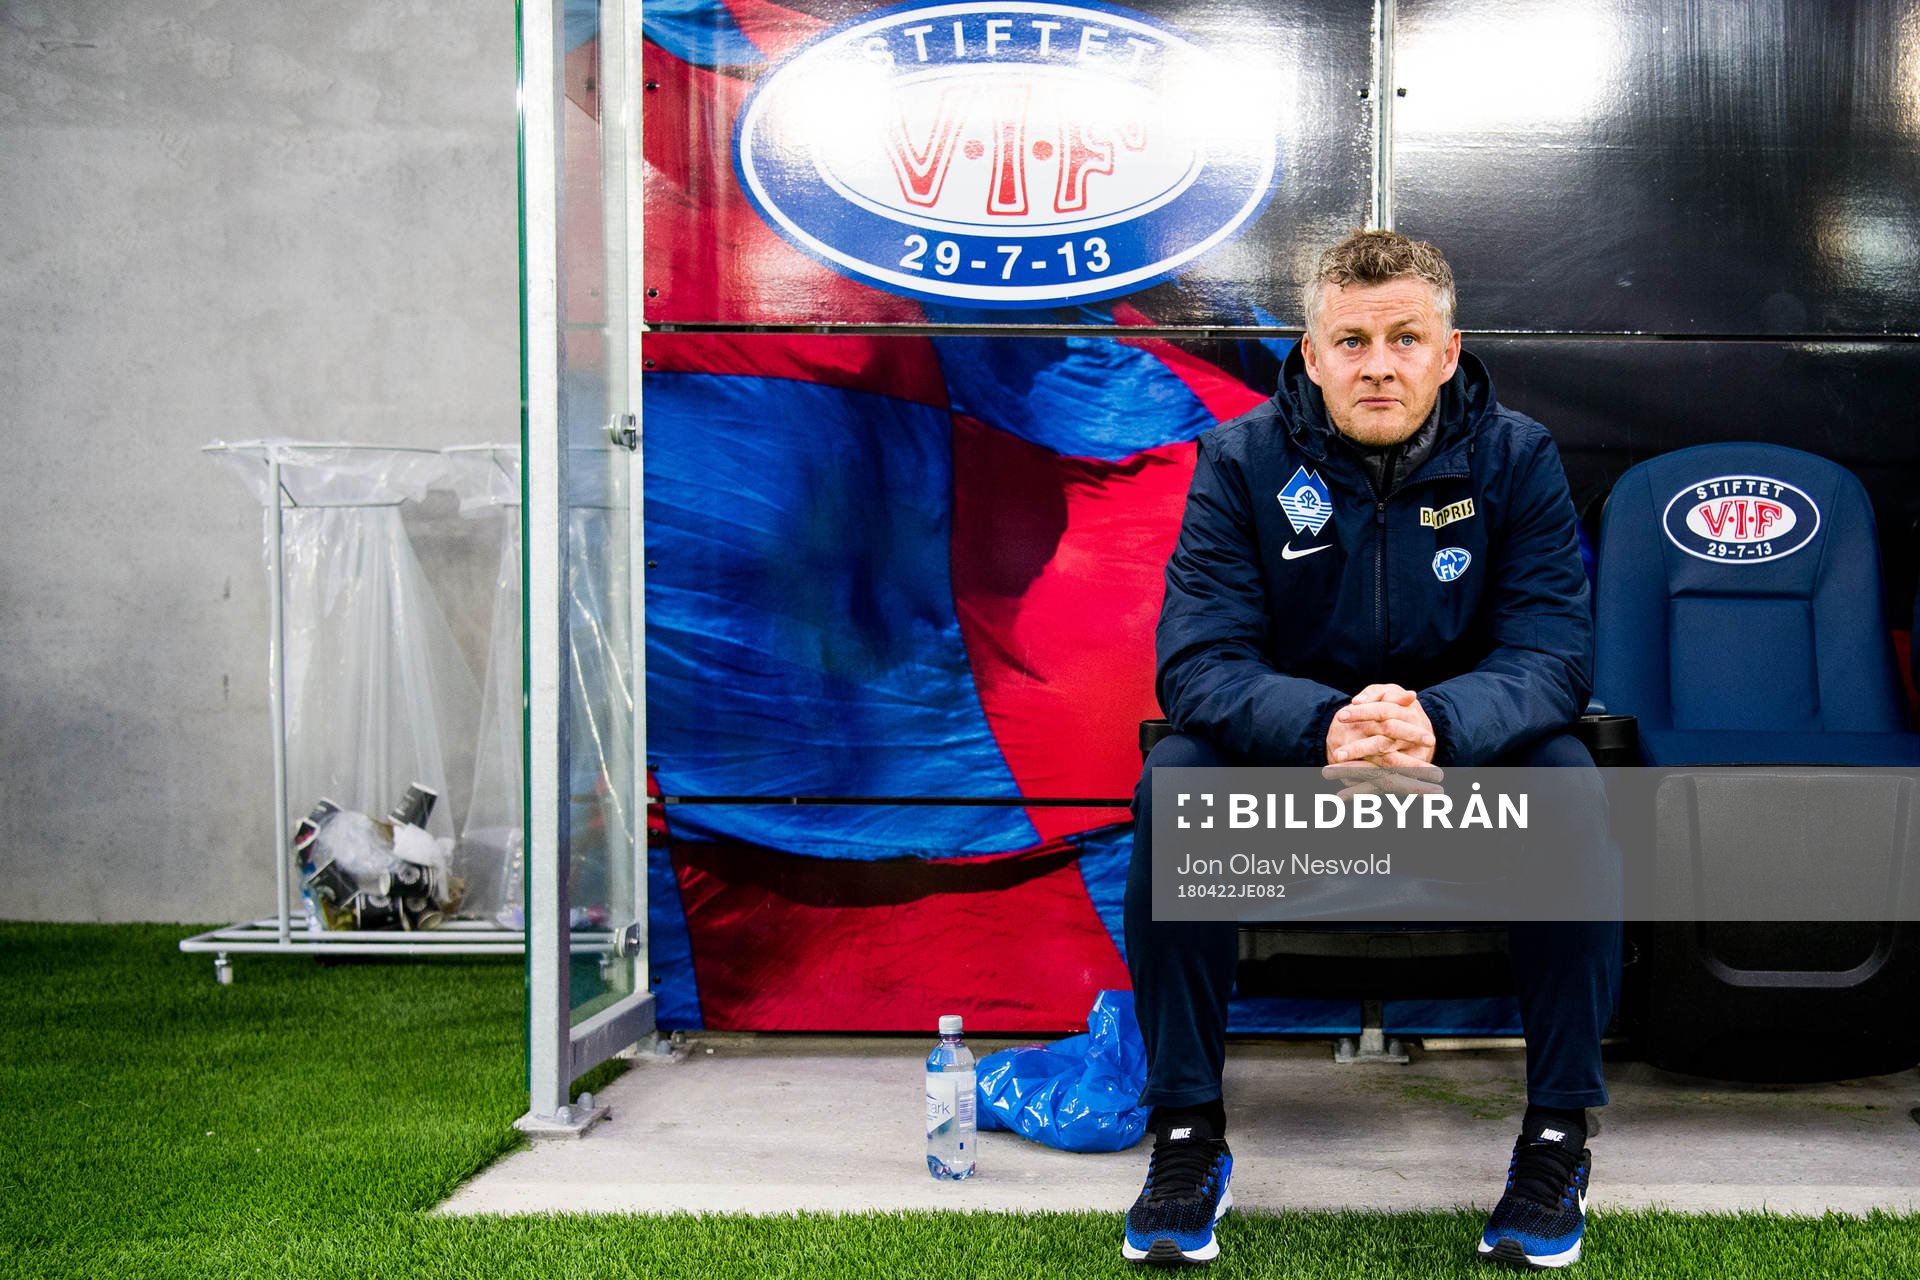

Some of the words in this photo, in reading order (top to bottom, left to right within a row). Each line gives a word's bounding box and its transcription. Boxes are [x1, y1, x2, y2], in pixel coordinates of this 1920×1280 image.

[900, 235, 1111, 280] 29-7-13
[1696, 481, 1784, 500] STIFTET
[1707, 542, 1773, 558] 29-7-13
[1169, 1127, 1193, 1140] NIKE
[1540, 1128, 1566, 1142] NIKE
